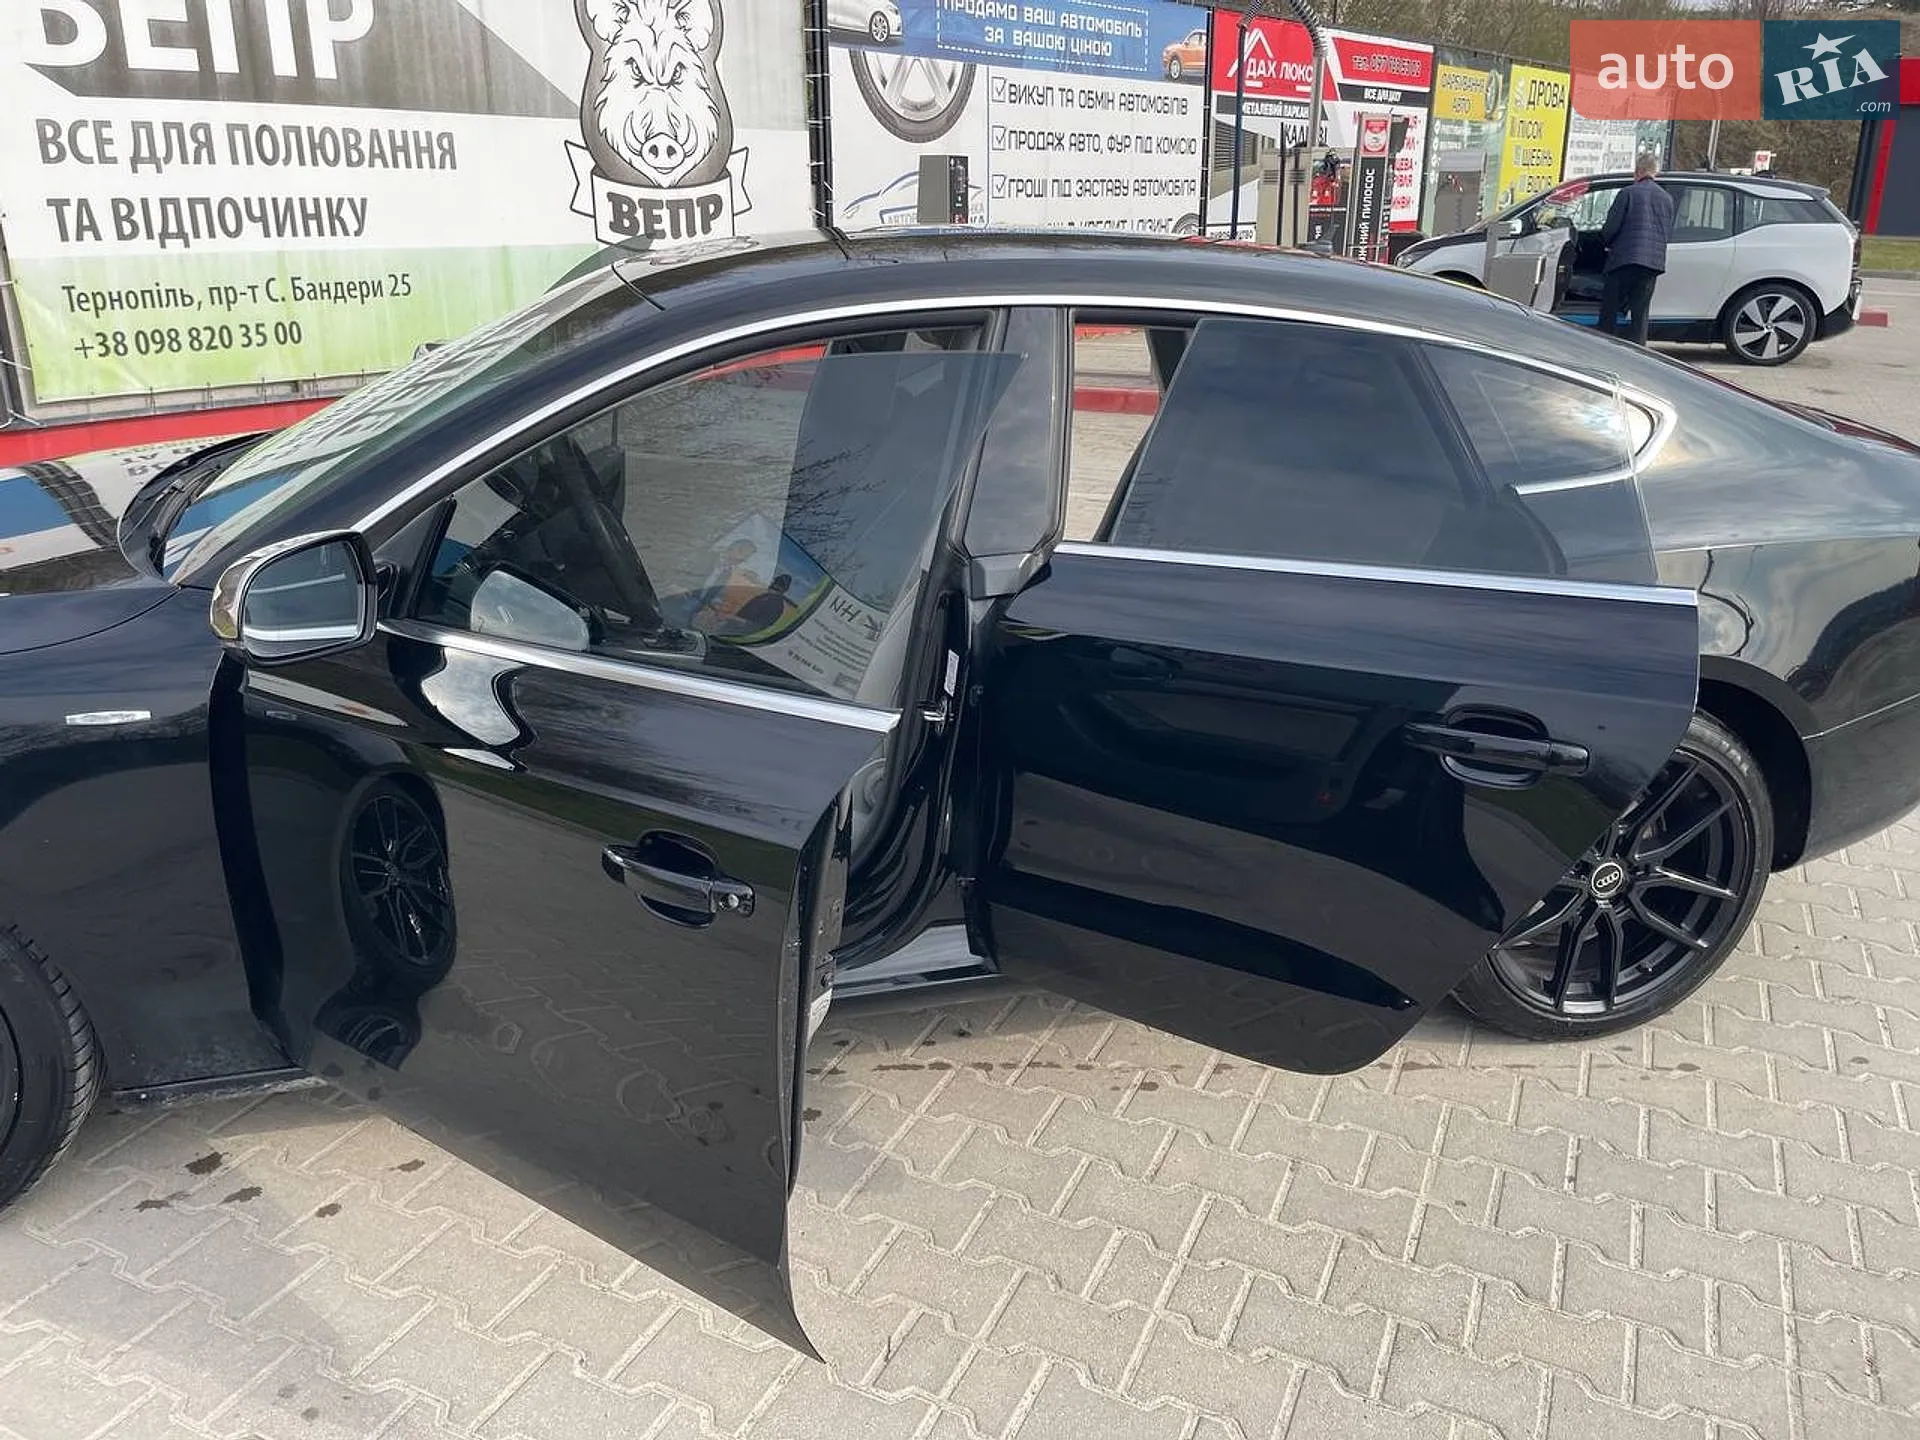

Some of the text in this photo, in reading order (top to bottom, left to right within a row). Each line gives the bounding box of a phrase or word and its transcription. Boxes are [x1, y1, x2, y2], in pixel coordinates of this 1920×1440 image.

[943, 0, 1143, 38] ПРОДАМО ВАШ АВТОМОБІЛЬ
[984, 26, 1113, 57] ЗА ВАШОЮ ЦІНОЮ
[1246, 58, 1313, 83] ДАХ ЛЮКС
[1008, 83, 1188, 115] ВИКУП ТА ОБМІН АВТОМОБІЛІВ
[1526, 79, 1566, 110] ДРОВА
[35, 118, 457, 173] ВСЕ ДЛЯ ПОЛЮВАННЯ
[1008, 130, 1065, 151] ПРОДАЖ
[1069, 132, 1103, 155] АВТО,
[1107, 133, 1131, 153] ФУР
[1135, 135, 1152, 154] ПІД
[1008, 177, 1048, 198] ГРОШІ
[1051, 178, 1072, 198] ПІД
[1075, 178, 1129, 197] ЗАСТАВУ
[45, 196, 368, 249] ТА ВІДПОЧИНКУ
[606, 191, 724, 240] ВЕПР
[62, 272, 412, 318] Тернопіль, пр-т С. Бандери 25
[74, 320, 303, 359] +38 098 820 35 00
